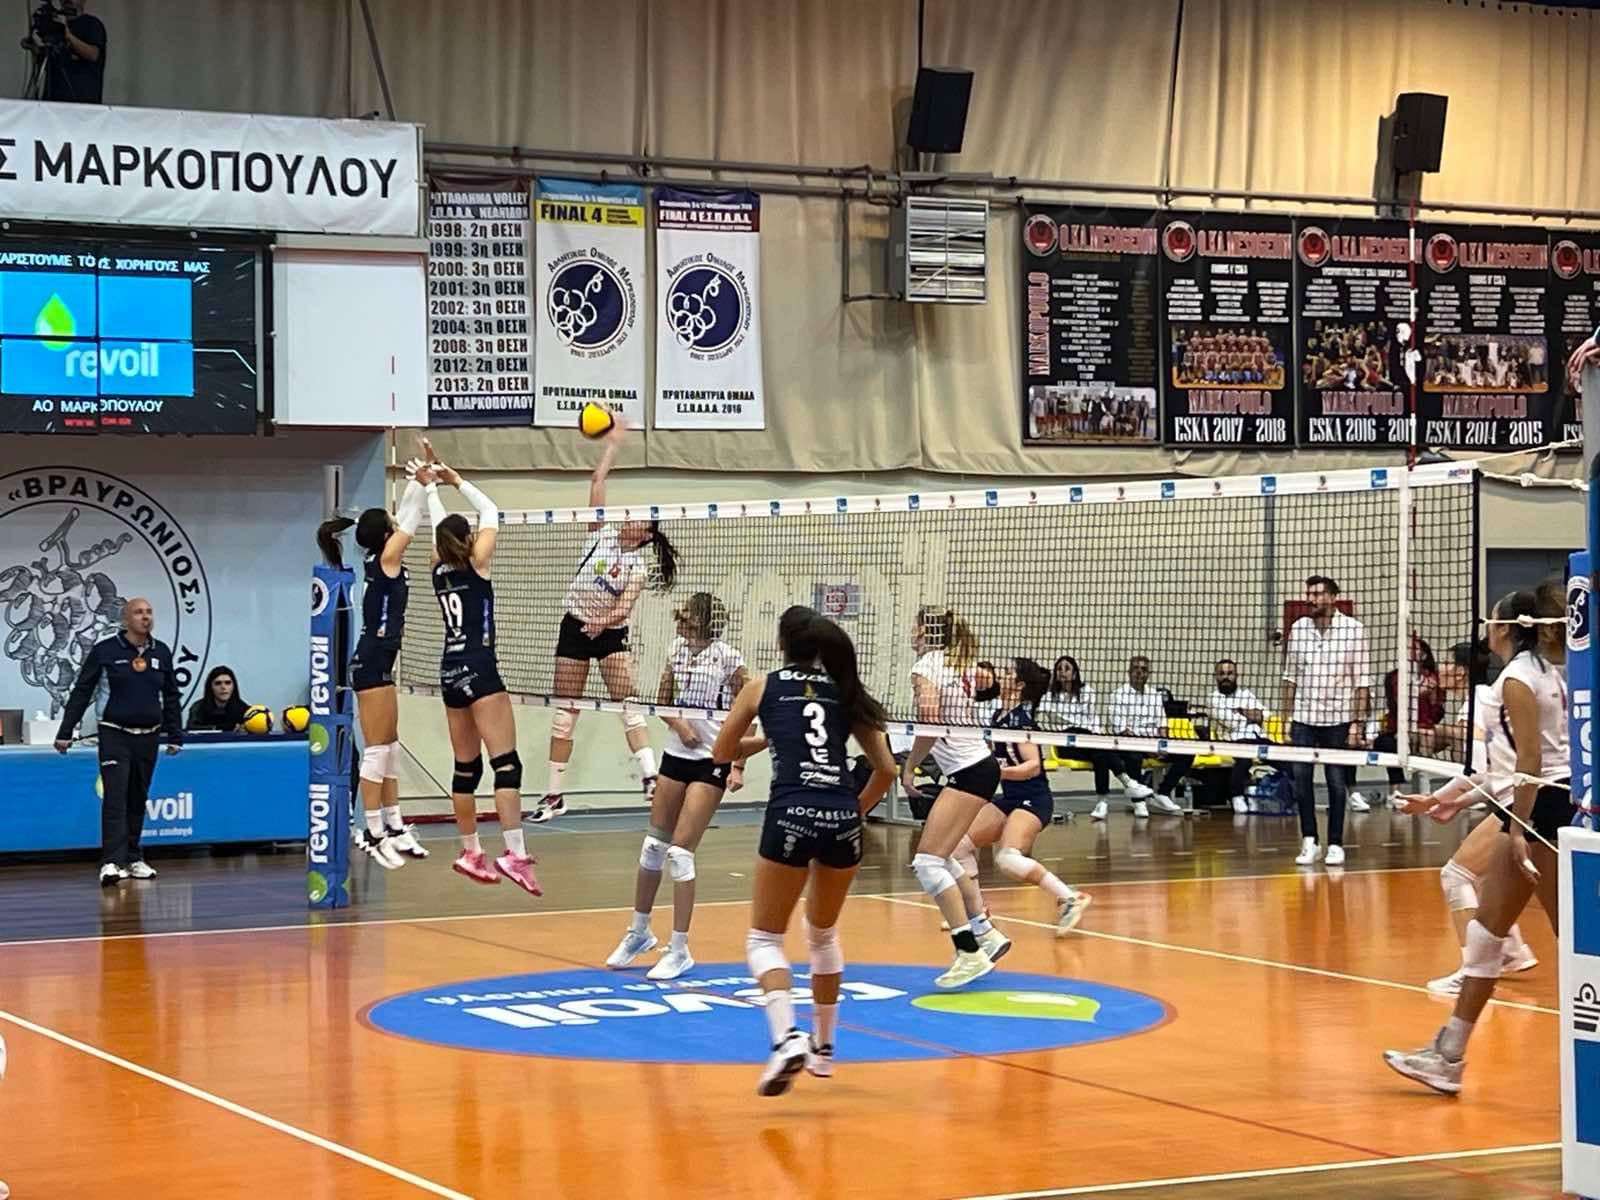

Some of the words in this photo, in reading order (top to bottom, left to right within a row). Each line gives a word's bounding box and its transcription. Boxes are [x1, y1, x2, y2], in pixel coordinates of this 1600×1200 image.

[34, 140, 397, 198] ΜΑΡΚΟΠΟΥΛΟΥ
[541, 204, 587, 222] FINAL
[592, 208, 602, 223] 4
[660, 209, 688, 222] FINAL
[430, 223, 467, 237] 1998:
[491, 223, 522, 237] ΘΕΣΗ
[431, 242, 467, 257] 1999:
[493, 242, 523, 257] ΘΕΣΗ
[116, 258, 178, 272] ΧΟΡΗΓΟΥΣ
[184, 261, 210, 273] ΜΑΣ
[429, 262, 468, 276] 2000:
[494, 262, 525, 276] ΘΕΣΗ
[430, 281, 468, 296] 2001:
[495, 281, 525, 296] ΘΕΣΗ
[431, 300, 469, 315] 2002:
[496, 300, 526, 315] ΘΕΣΗ
[432, 320, 470, 334] 2004:
[496, 320, 527, 334] ΘΕΣΗ
[433, 339, 471, 353] 2008:
[497, 339, 528, 353] ΘΕΣΗ
[65, 343, 159, 378] revoil
[434, 358, 472, 372] 2012:
[497, 358, 528, 372] ΘΕΣΗ
[435, 377, 474, 392] 2013:
[498, 377, 529, 392] ΘΕΣΗ
[609, 389, 637, 400] ΟΜΑΔΑ
[727, 391, 754, 400] ΟΜΑΔΑ
[33, 401, 54, 412] ΑΟ
[454, 396, 533, 410] ΜΑΡΚΟΠΟΥΛΟΥ
[1175, 416, 1209, 442] ESKA
[1213, 417, 1244, 442] 2017
[1256, 418, 1286, 442] 2018
[1309, 417, 1342, 442] ESKA
[1346, 418, 1376, 442] 2016
[1425, 420, 1461, 444] ESKA
[1465, 421, 1497, 445] 2014
[1509, 421, 1543, 445] 2015
[441, 592, 463, 627] 19
[311, 636, 330, 716] revoil
[803, 702, 828, 747] 3
[787, 806, 858, 820] ROCABELLA
[309, 784, 330, 864] revoil
